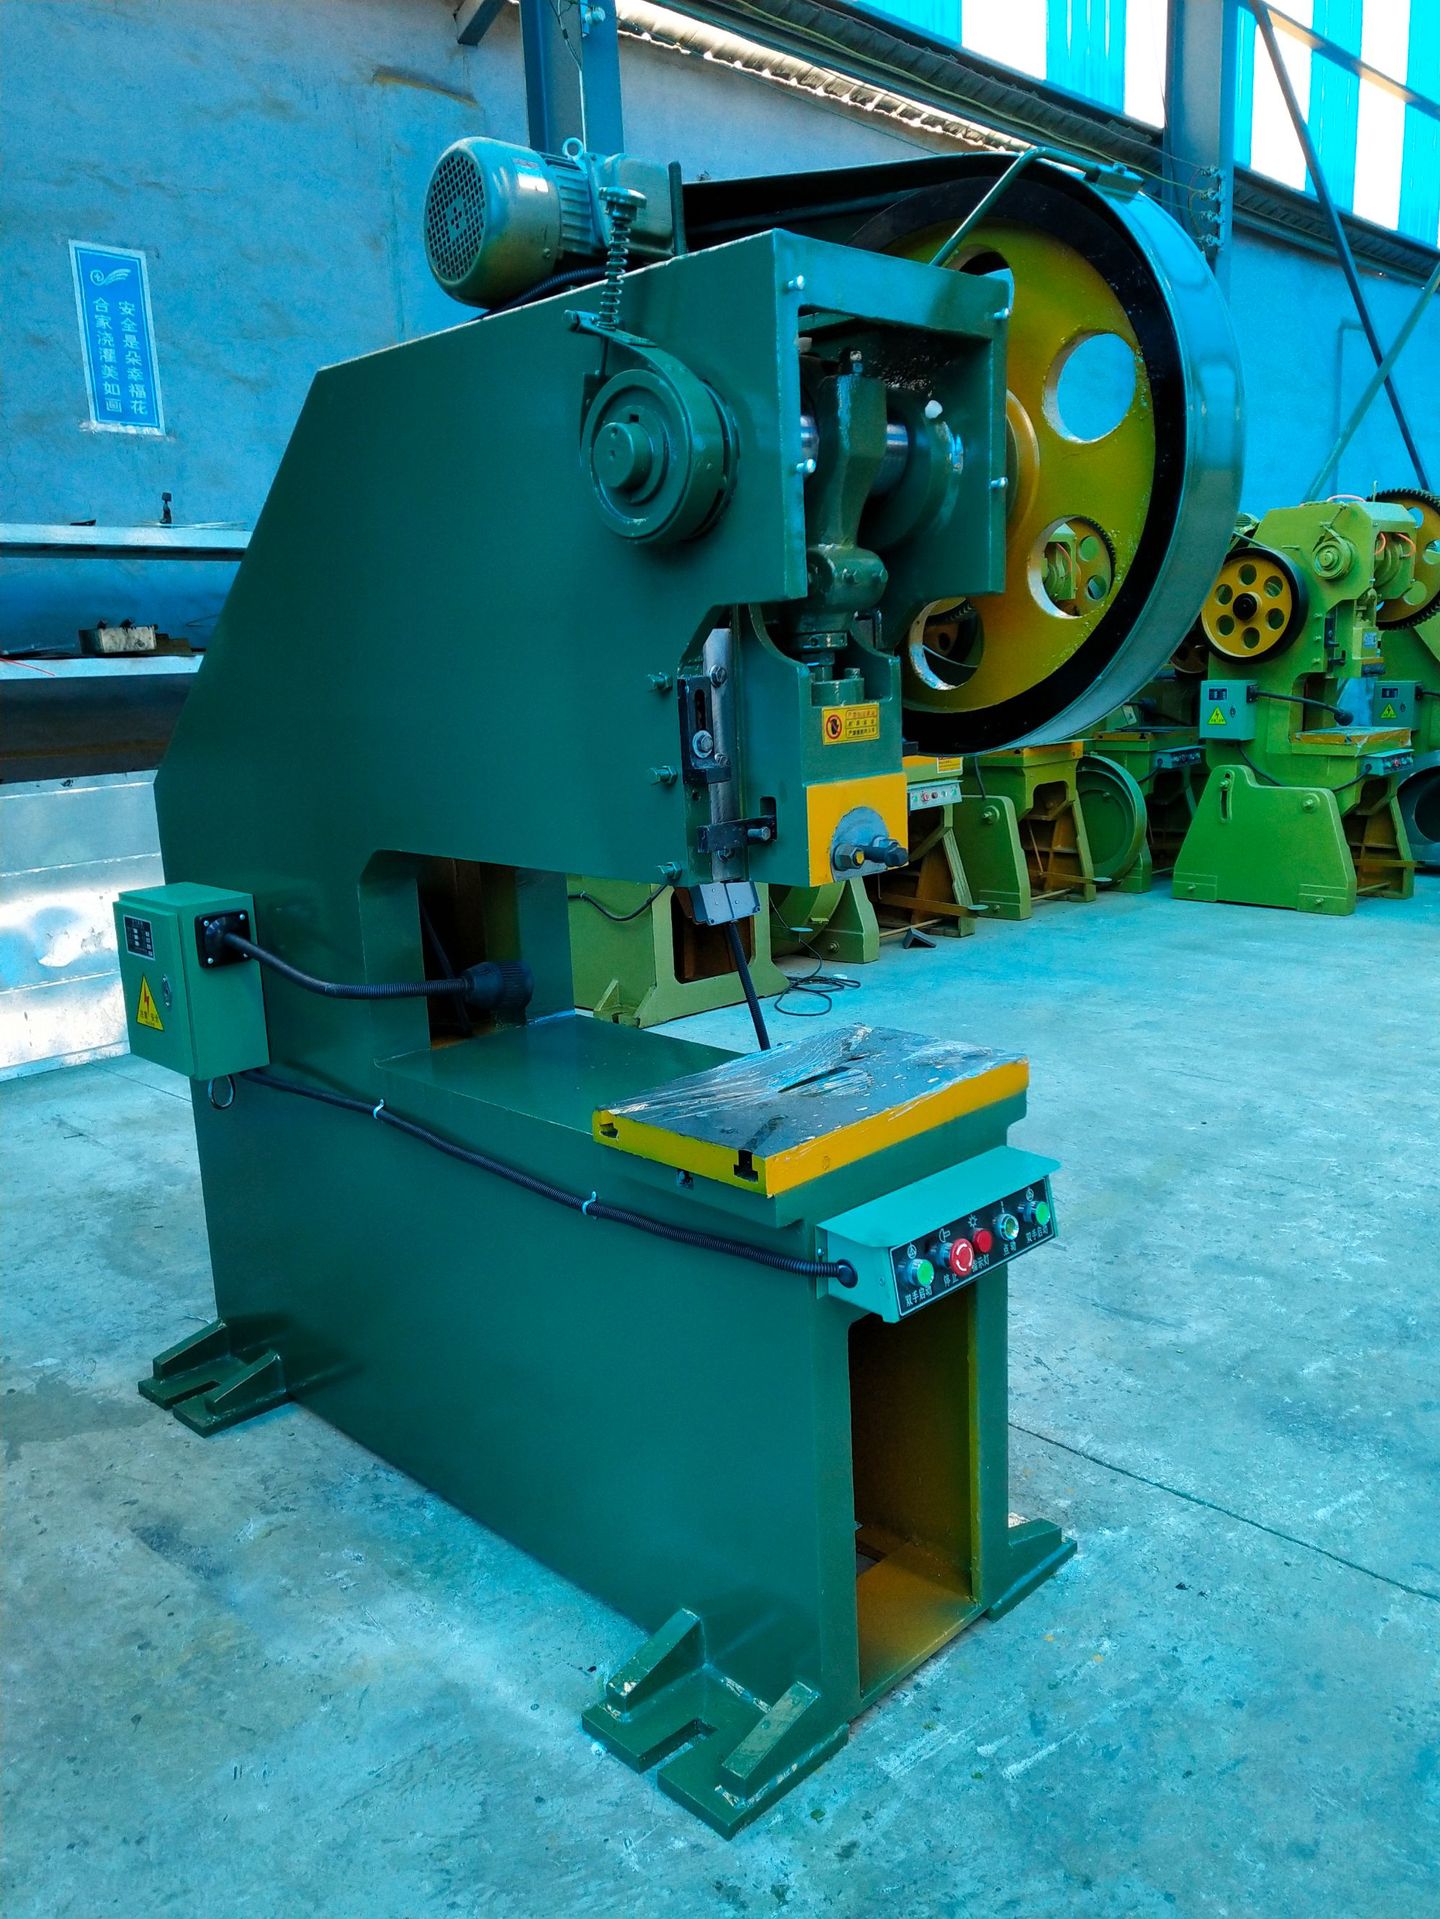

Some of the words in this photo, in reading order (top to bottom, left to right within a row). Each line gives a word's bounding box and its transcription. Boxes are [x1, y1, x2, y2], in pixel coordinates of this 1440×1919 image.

[118, 301, 147, 414] 安全是朵幸福花
[905, 1285, 933, 1307] 双手启动
